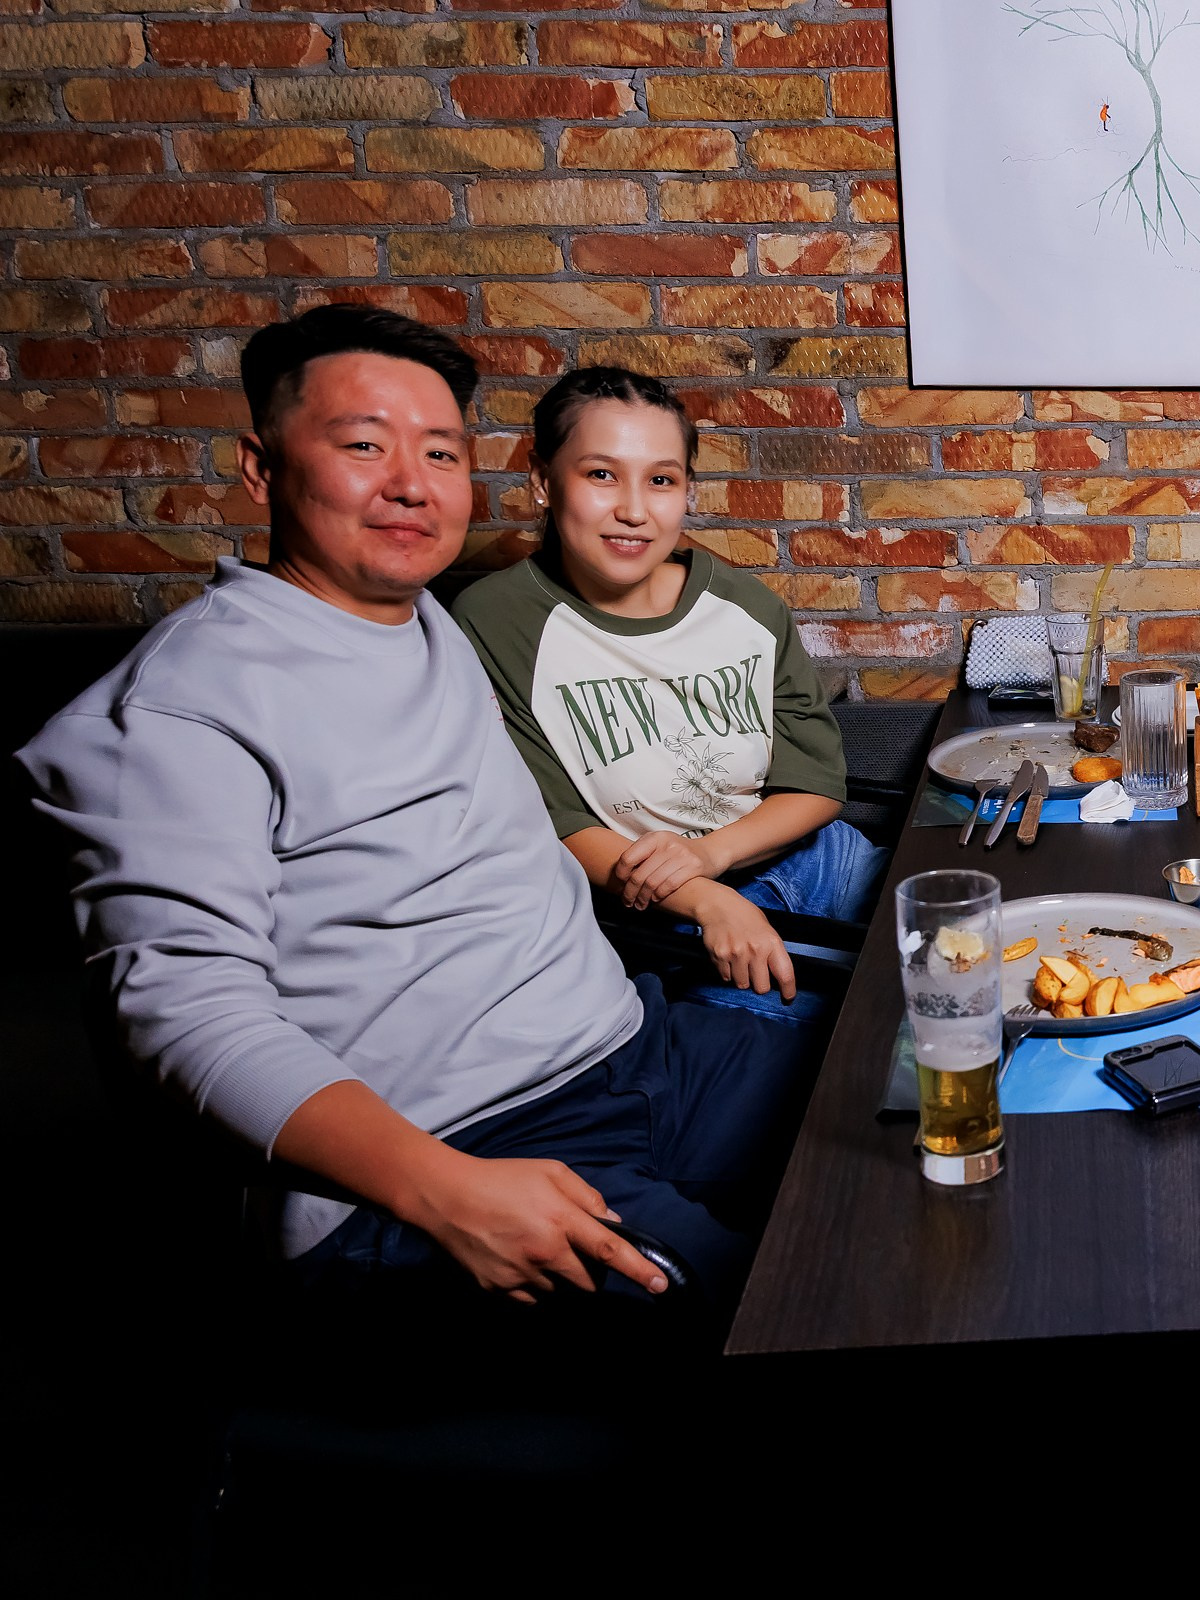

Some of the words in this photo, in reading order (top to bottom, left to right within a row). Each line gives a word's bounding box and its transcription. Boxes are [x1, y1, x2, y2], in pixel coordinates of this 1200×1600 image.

[555, 677, 662, 776] NEW
[659, 654, 771, 739] YORK
[612, 799, 644, 815] EST.
